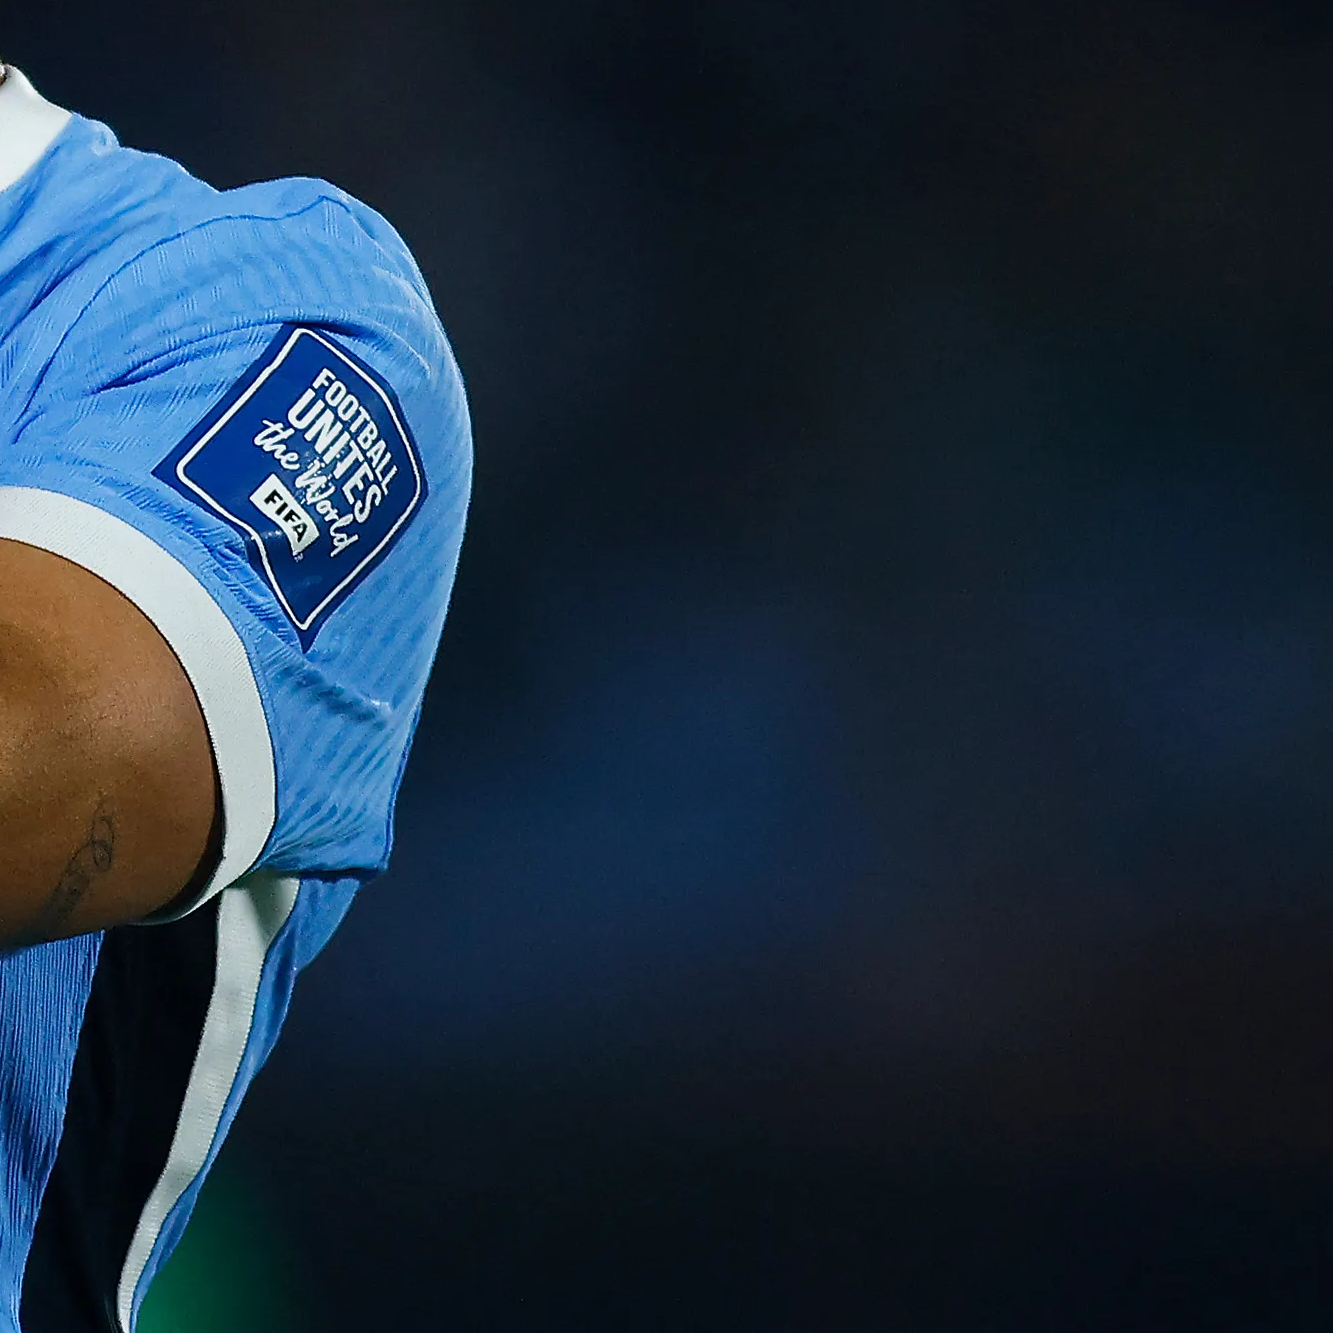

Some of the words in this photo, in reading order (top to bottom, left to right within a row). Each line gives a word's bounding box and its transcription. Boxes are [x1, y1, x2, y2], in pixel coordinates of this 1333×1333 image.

[254, 419, 300, 471] the
[295, 459, 359, 557] World
[288, 388, 382, 523] UNITES
[312, 367, 398, 495] FOOTBALL
[264, 489, 309, 543] FIFA
